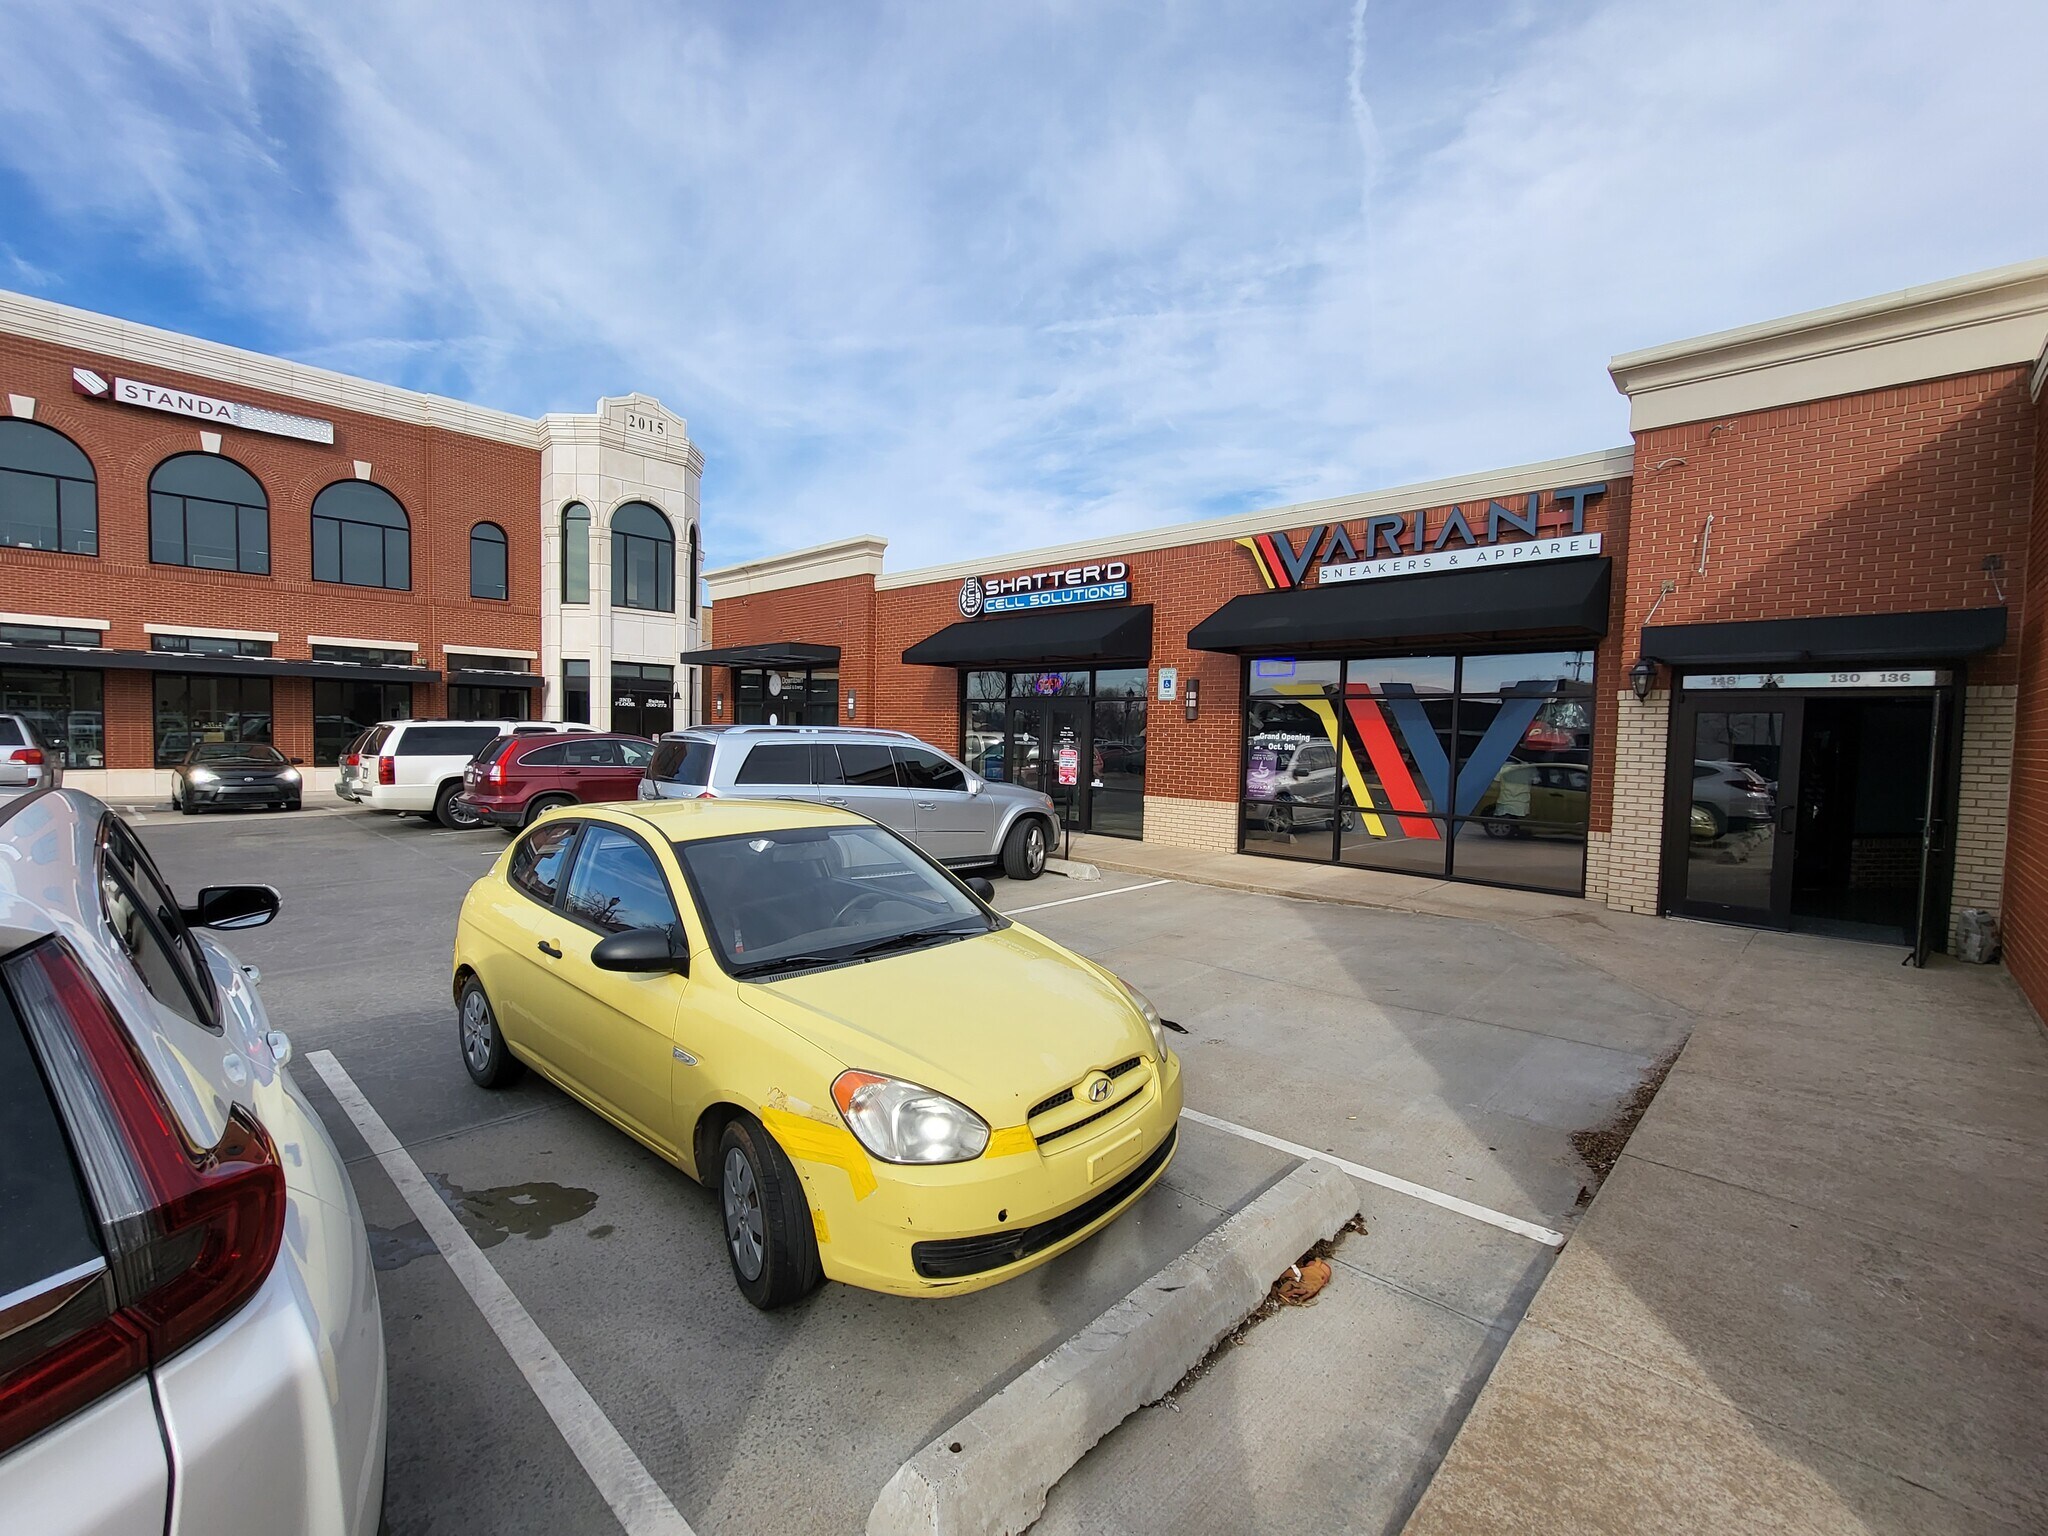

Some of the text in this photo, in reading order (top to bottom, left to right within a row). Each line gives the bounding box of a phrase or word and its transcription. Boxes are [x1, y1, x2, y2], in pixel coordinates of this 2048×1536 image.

[125, 385, 231, 419] STANDA
[628, 415, 664, 435] 2015
[1273, 484, 1606, 585] VARIANT
[1321, 539, 1597, 579] SNEAKERS & APPAREL
[985, 562, 1125, 596] SHATTER'D
[986, 585, 1125, 610] CELL SOLUTIONS
[1830, 674, 1861, 683] 130
[1880, 673, 1911, 683] 136
[1281, 733, 1310, 742] Opening
